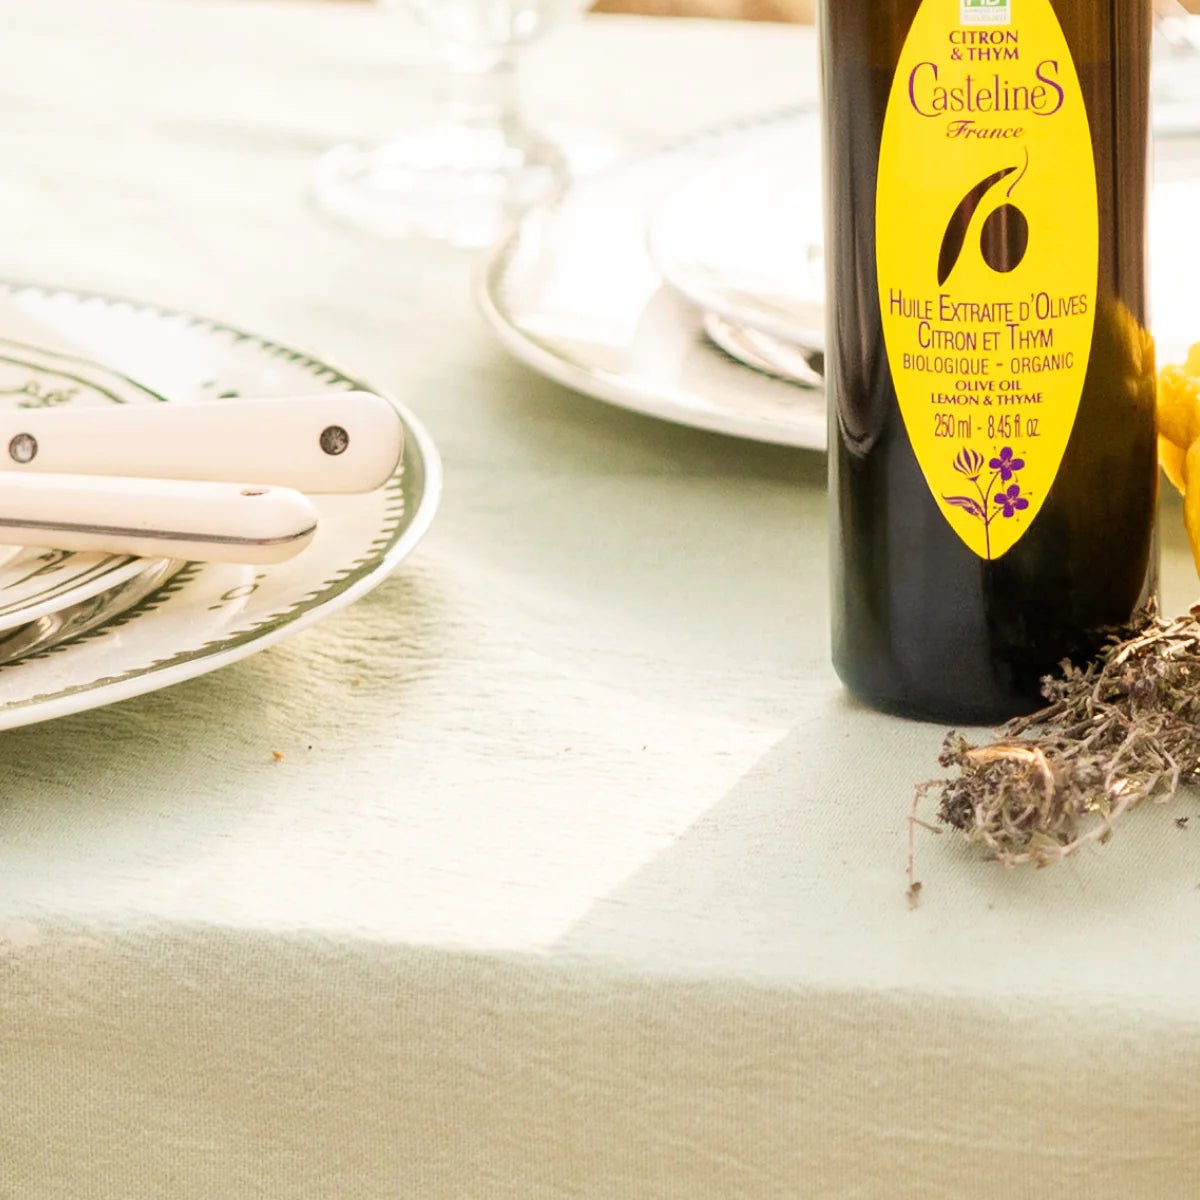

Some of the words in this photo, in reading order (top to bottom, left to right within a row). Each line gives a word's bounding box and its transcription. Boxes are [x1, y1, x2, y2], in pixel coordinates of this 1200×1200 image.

[949, 30, 1019, 45] CITRON
[950, 48, 962, 61] &
[967, 47, 1019, 61] THYM
[908, 60, 1065, 118] CastelineS
[946, 119, 1024, 140] France
[902, 352, 989, 376] BIOLOGIQUE
[1010, 352, 1074, 375] ORGANIC
[955, 380, 995, 391] OLIVE
[999, 380, 1022, 391] OIL
[931, 392, 979, 406] LEMON
[983, 394, 993, 406] &
[996, 392, 1043, 406] THYME
[934, 412, 954, 438] 250
[958, 414, 972, 439] ml
